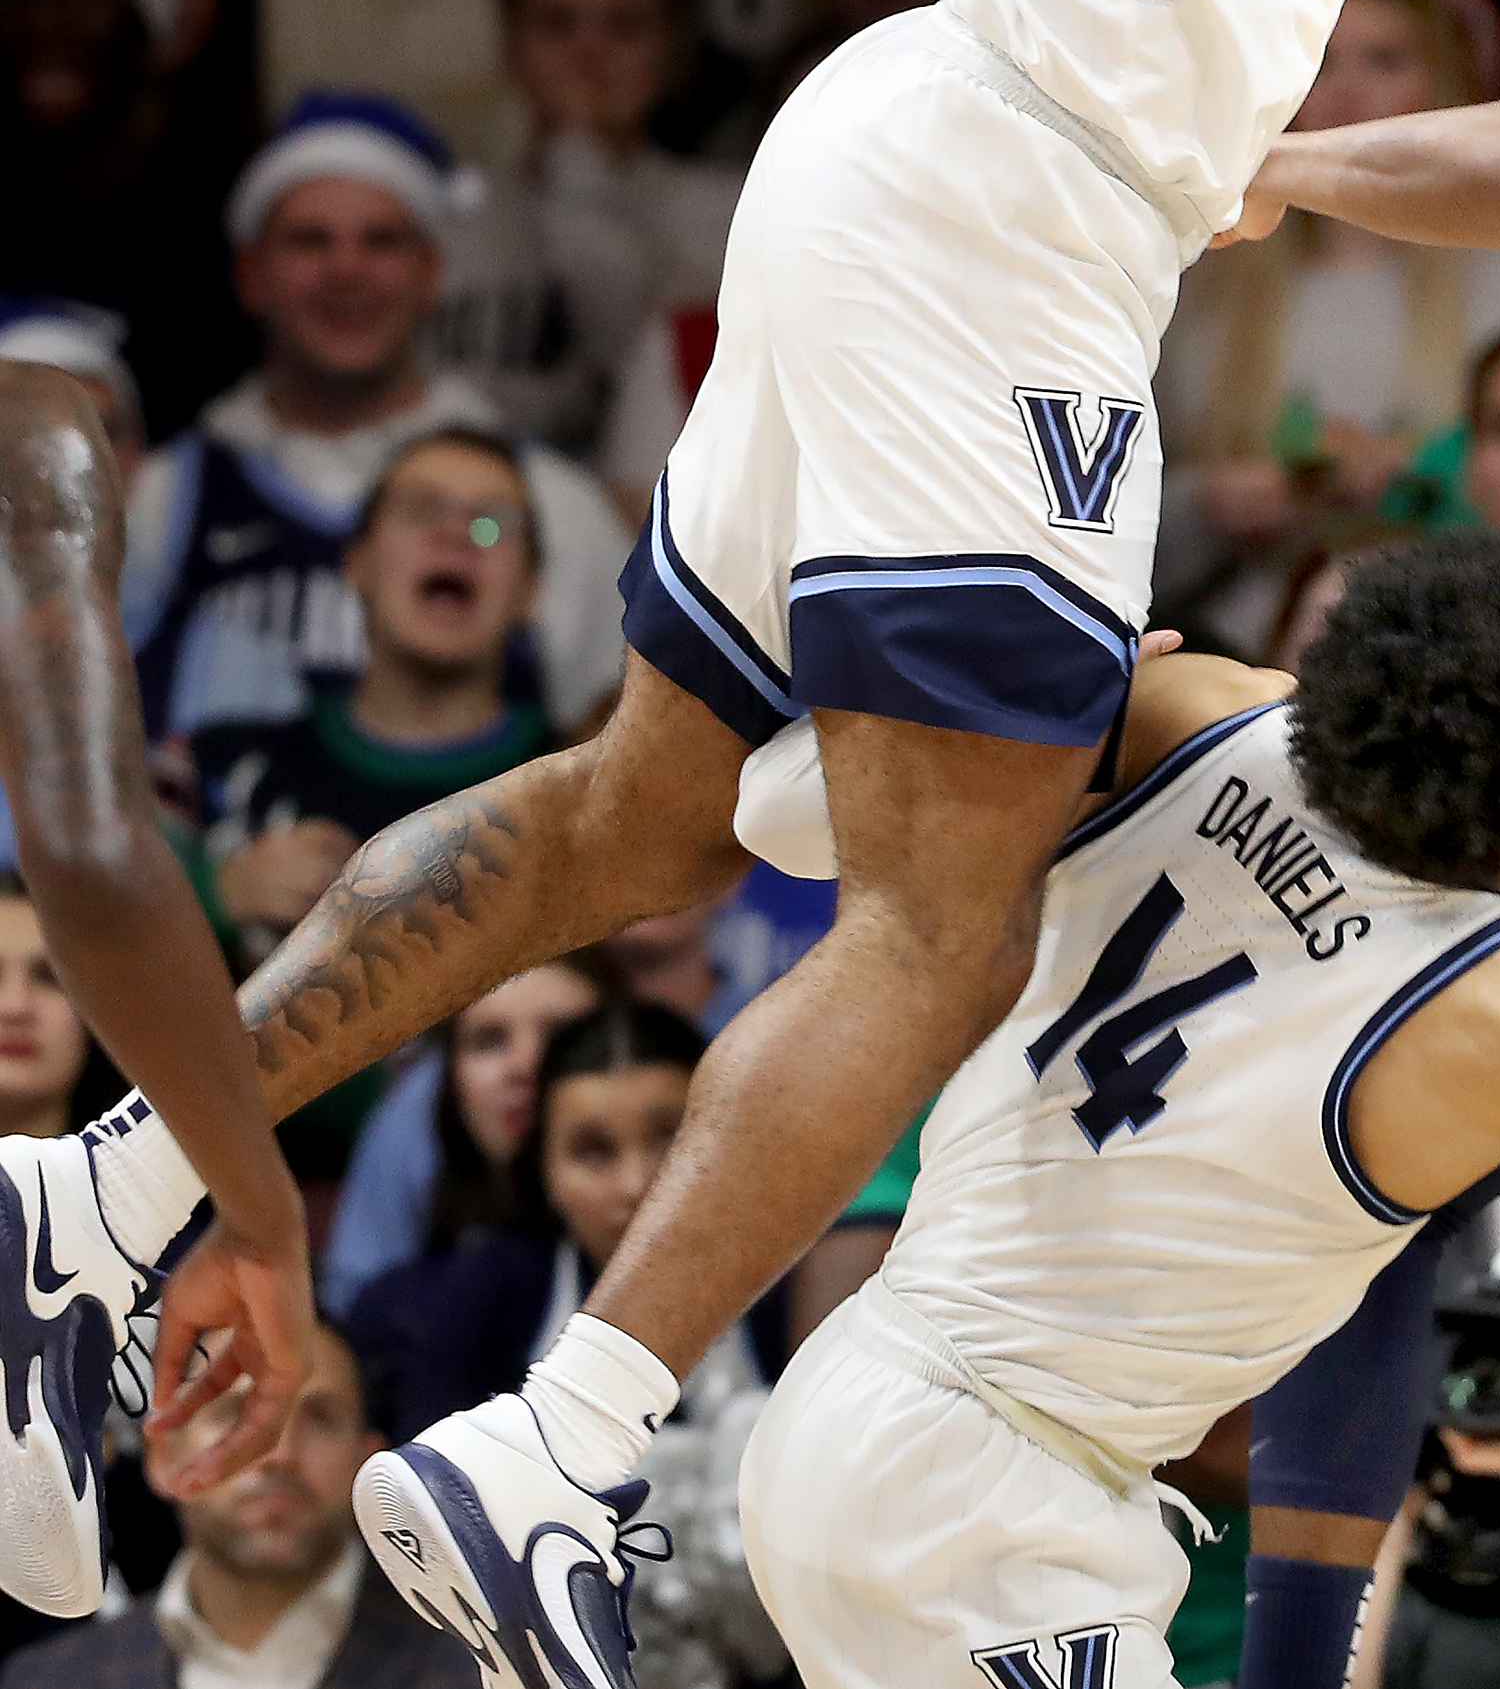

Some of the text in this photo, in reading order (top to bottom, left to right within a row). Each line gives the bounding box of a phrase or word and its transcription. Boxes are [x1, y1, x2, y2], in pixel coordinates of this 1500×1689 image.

[1013, 386, 1145, 535] V
[1196, 775, 1371, 962] DANIELS
[1025, 869, 1260, 1155] 14
